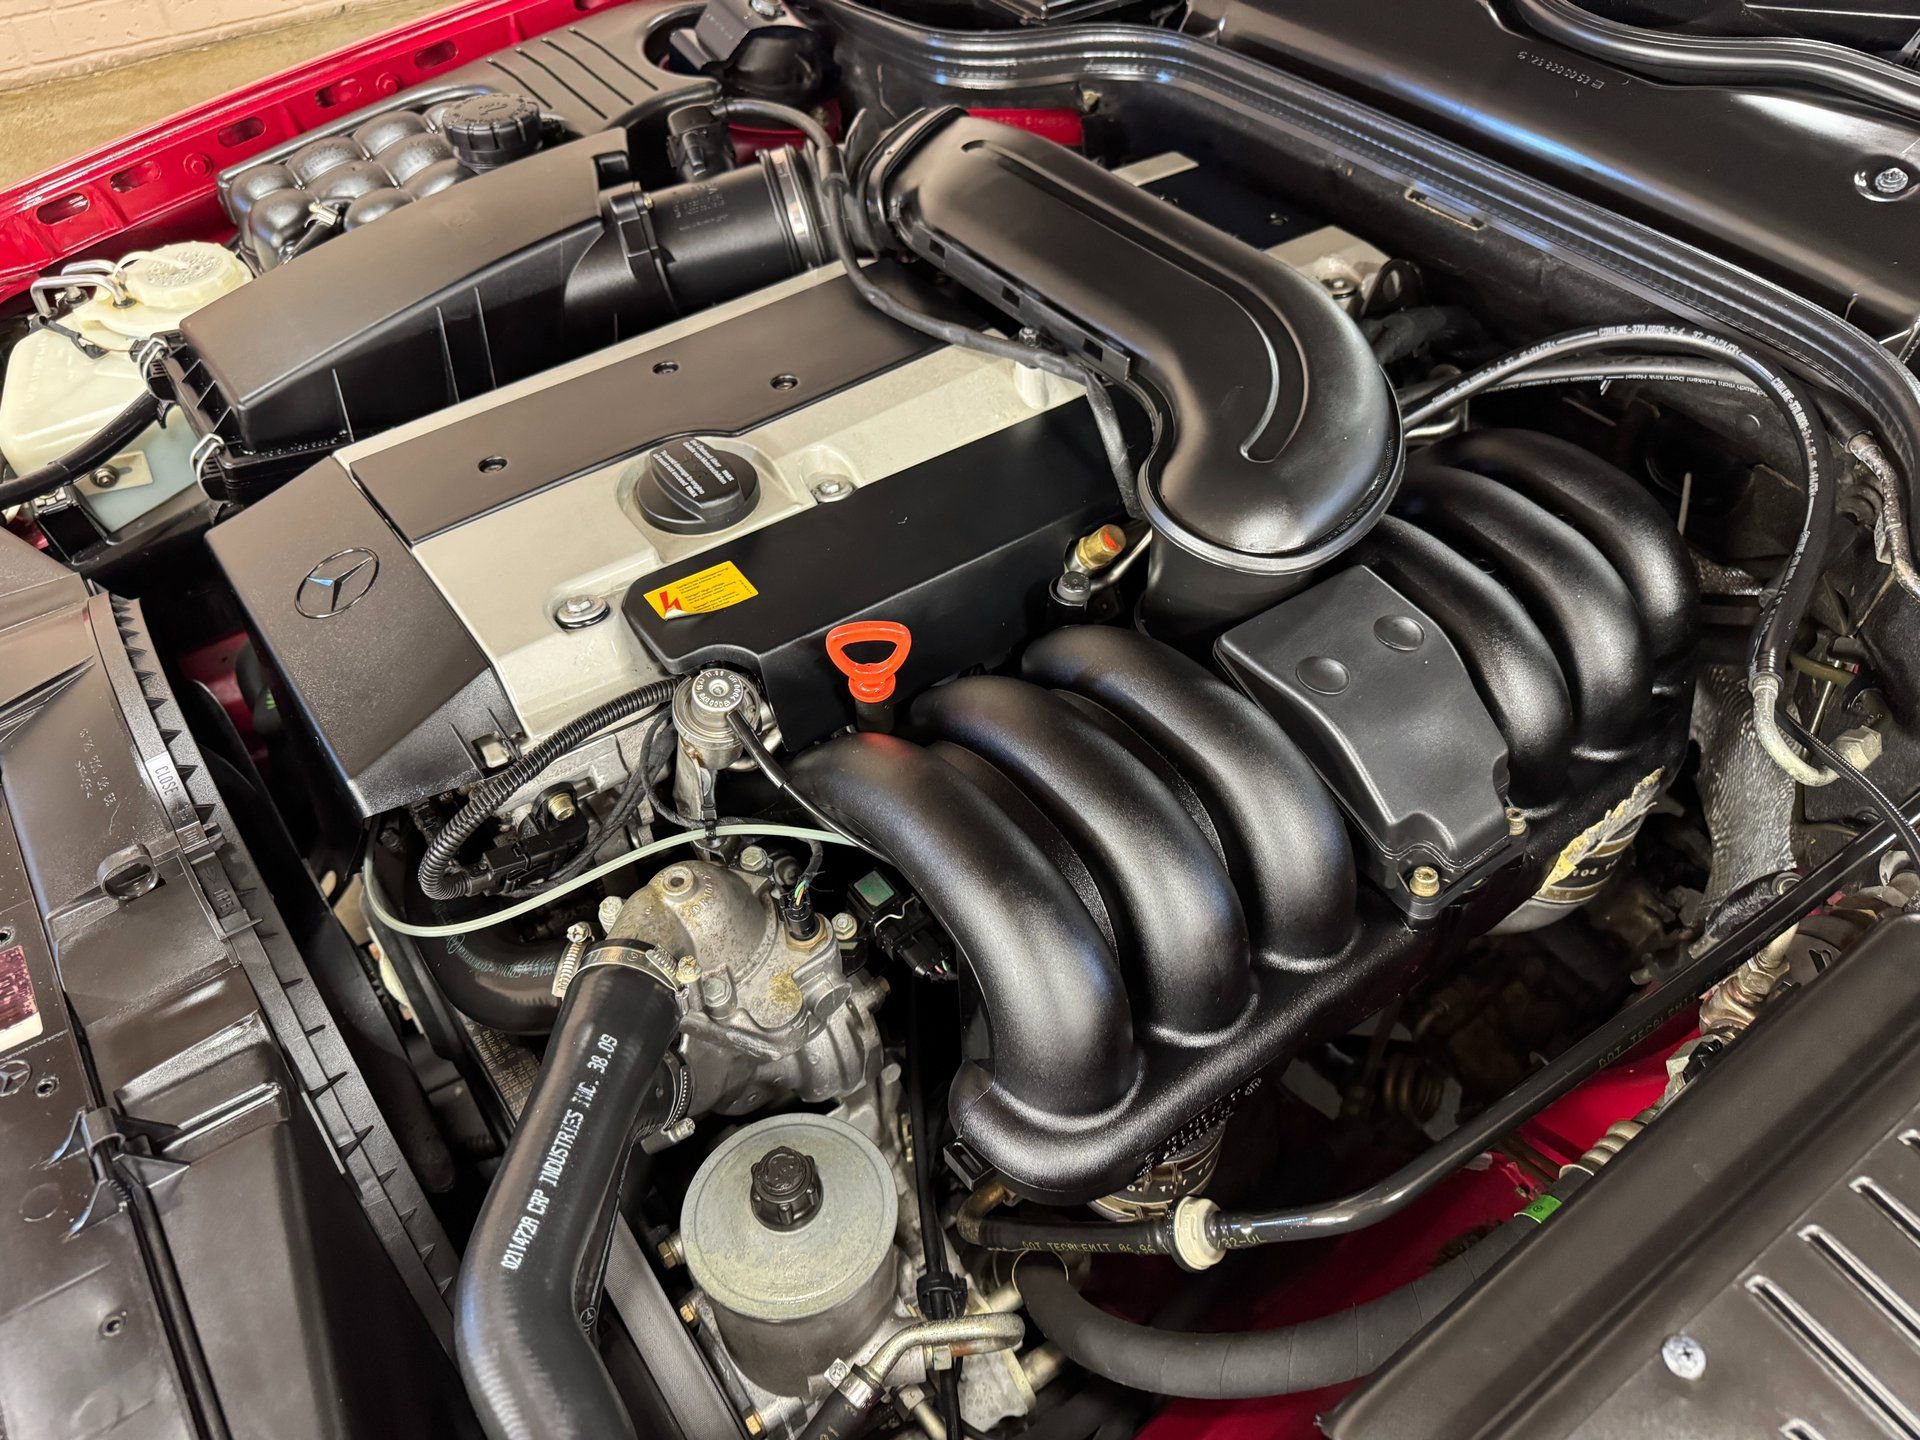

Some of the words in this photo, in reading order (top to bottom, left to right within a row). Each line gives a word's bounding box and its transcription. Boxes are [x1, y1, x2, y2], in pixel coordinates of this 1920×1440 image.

[684, 484, 698, 498] max
[720, 468, 735, 482] max
[152, 763, 180, 797] CLOSE
[585, 1030, 620, 1075] 38.09
[492, 1070, 524, 1119] ES-BENZ
[536, 1106, 588, 1187] INDUSTRIES
[524, 1186, 553, 1216] CRP
[498, 1212, 541, 1273] 0211472A
